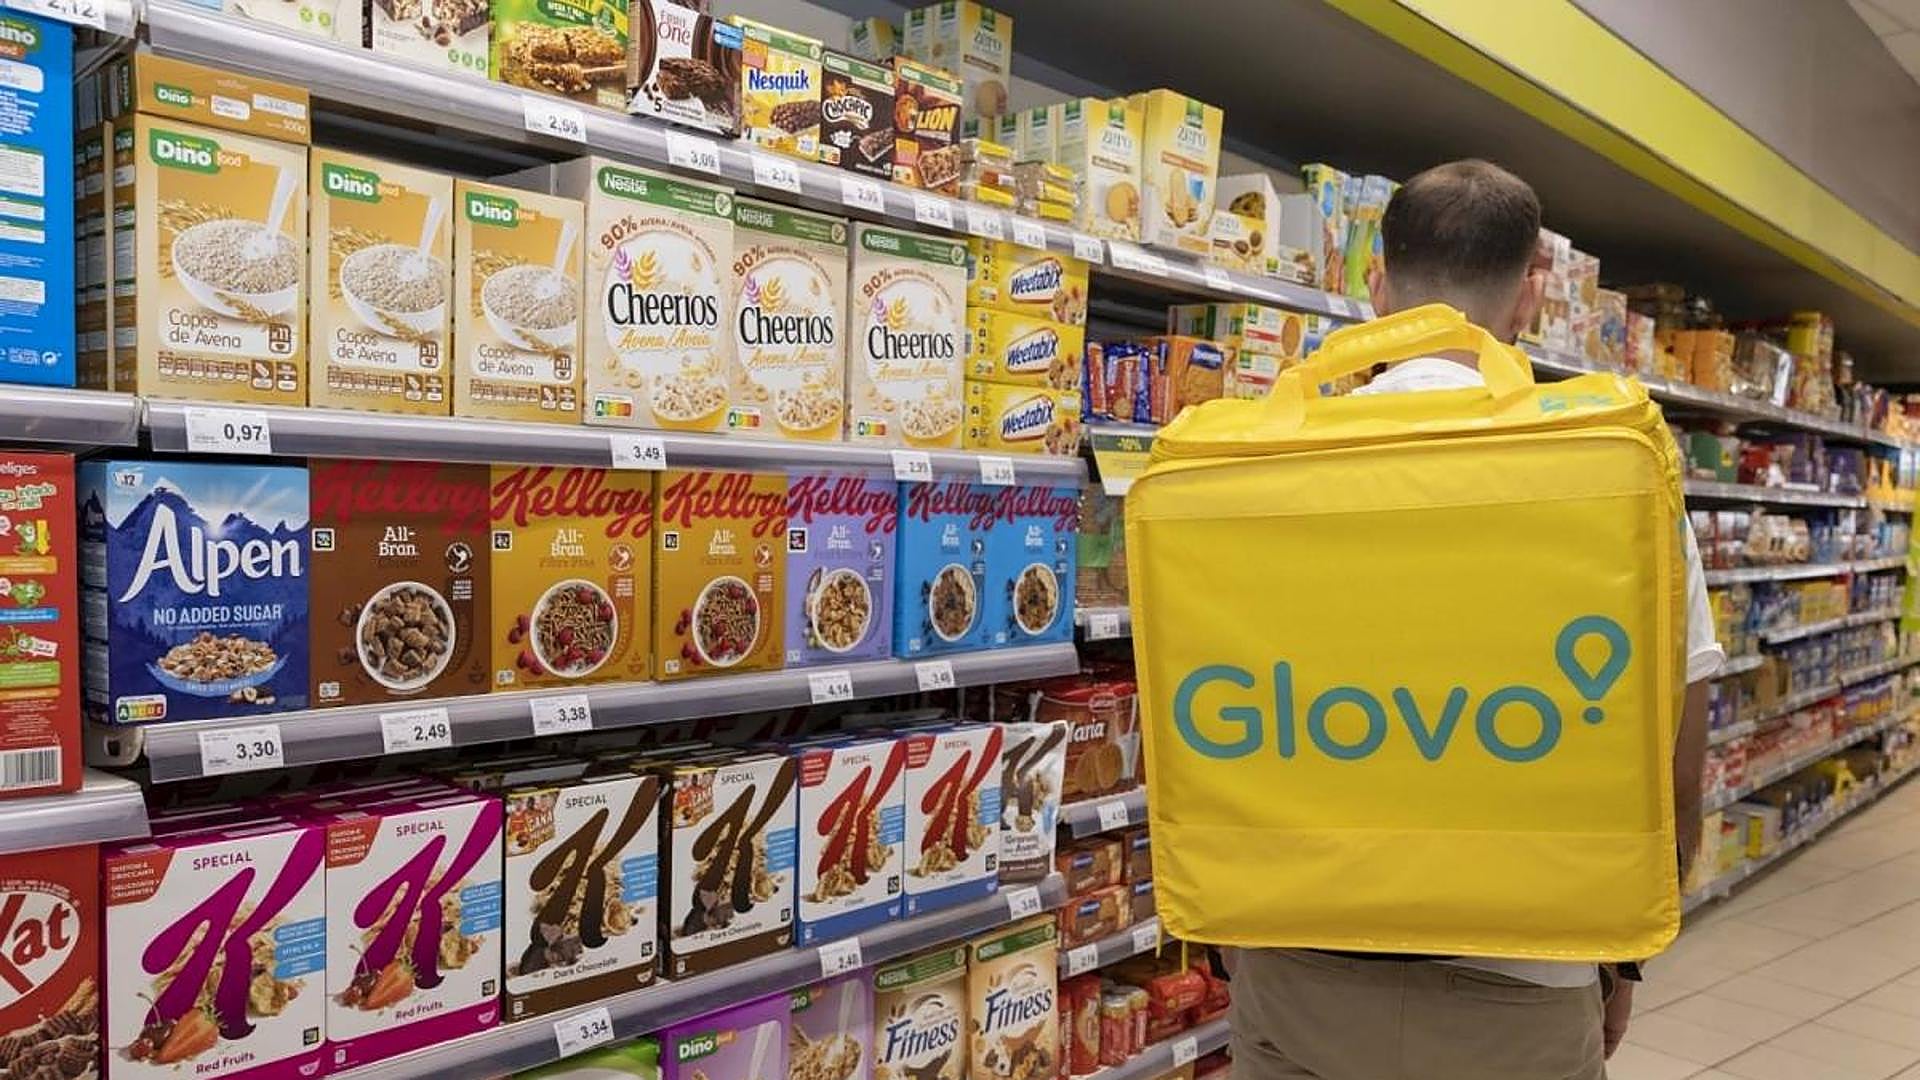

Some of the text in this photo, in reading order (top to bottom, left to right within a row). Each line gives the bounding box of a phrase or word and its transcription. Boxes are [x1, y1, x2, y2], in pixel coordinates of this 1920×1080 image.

[658, 23, 691, 46] One
[748, 69, 809, 96] Nesquik
[916, 105, 958, 131] LION
[156, 138, 212, 167] Dino
[328, 171, 375, 197] Dino
[470, 200, 513, 222] Dino
[601, 215, 638, 250] 90%
[1010, 267, 1061, 296] Weetabix
[608, 282, 718, 327] Cheerios
[169, 308, 218, 334] Copos
[739, 306, 834, 345] Cheerios
[169, 329, 241, 348] de Avena
[336, 328, 378, 347] Copos
[868, 325, 954, 360] Cheerios
[336, 344, 397, 364] de Avena
[1006, 336, 1058, 366] Weetabix
[223, 423, 263, 443] 0,97
[633, 446, 660, 460] 3,49
[384, 526, 416, 541] All-
[556, 528, 584, 543] All-
[118, 503, 304, 603] Alpen
[379, 542, 416, 556] Bran
[153, 604, 283, 626] NO ADDED SUGAR
[558, 707, 586, 722] 3,38
[1173, 661, 1562, 763] Glovo
[414, 725, 447, 741] 2,49
[236, 740, 275, 759] 3,30
[721, 773, 755, 786] SPECIAL
[565, 794, 607, 809] SPECIAL
[396, 820, 445, 837] SPECIAL
[192, 851, 253, 871] SPECIAL
[353, 799, 502, 990] K
[142, 828, 327, 1041] K
[552, 957, 619, 981] Dark Chocolate
[395, 1001, 443, 1021] Red Fruits
[984, 989, 1052, 1034] Fitness
[580, 1020, 608, 1040] 3,34
[884, 1018, 958, 1063] Fitness
[679, 1038, 714, 1059] Dino
[195, 1051, 255, 1075] Red Fruits
